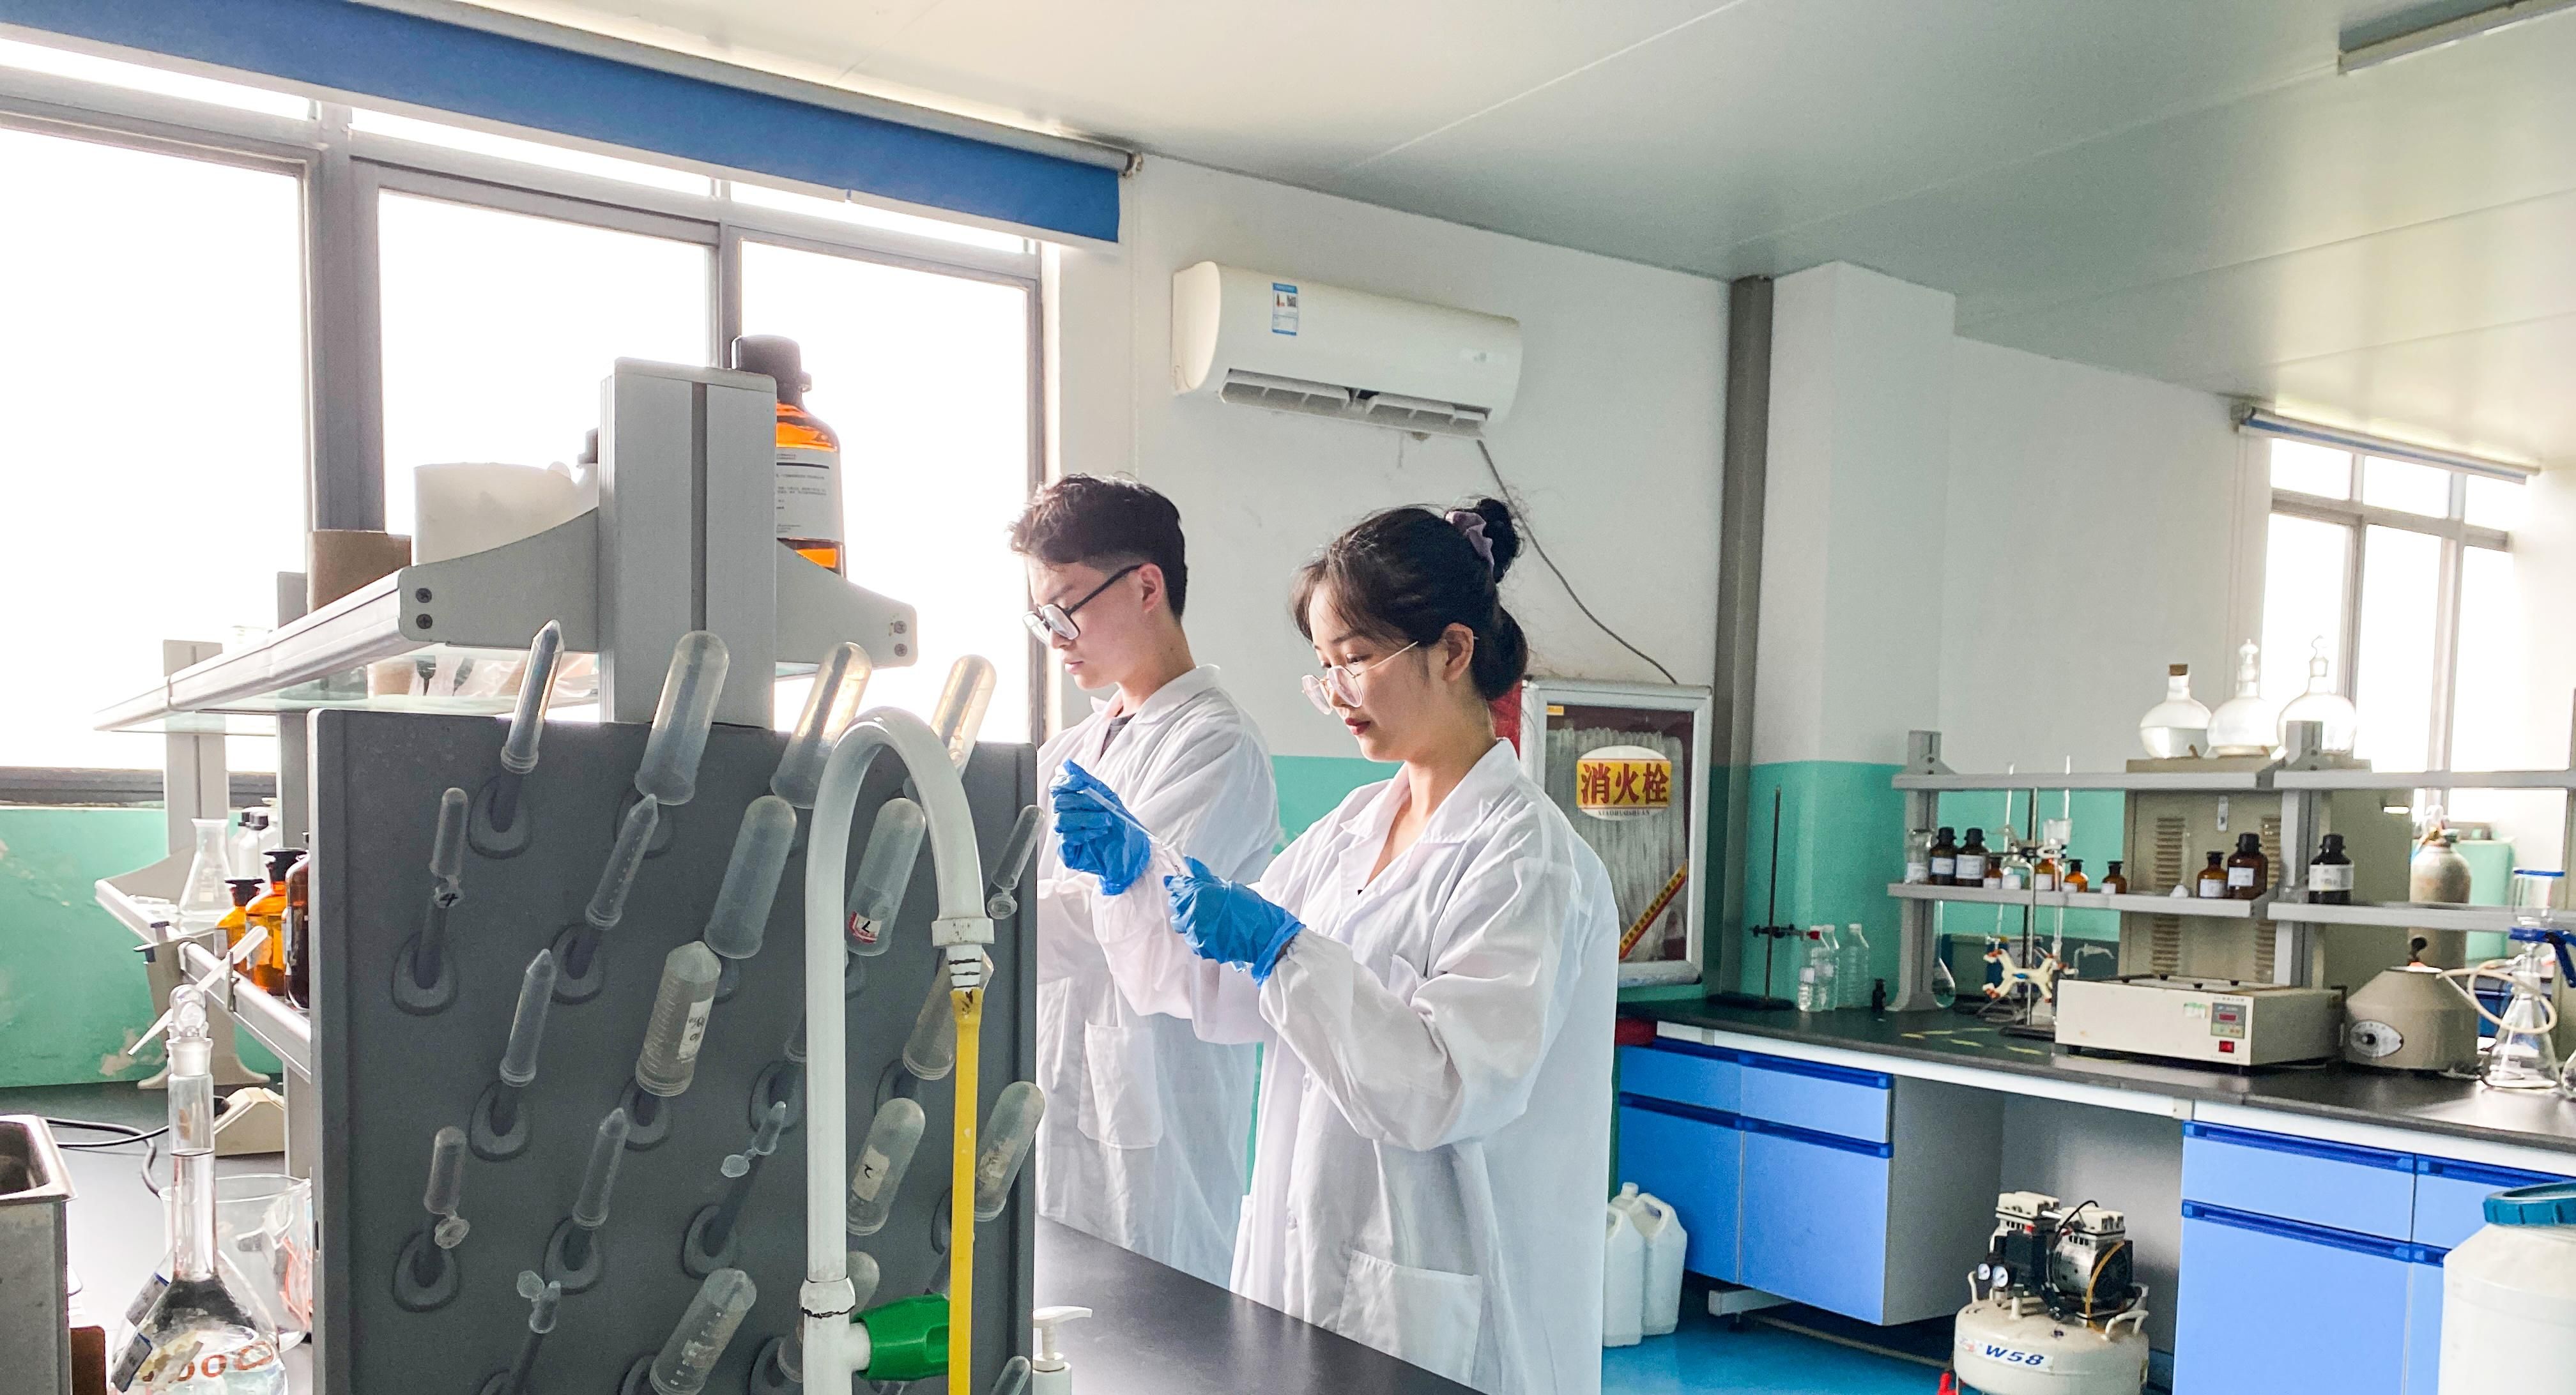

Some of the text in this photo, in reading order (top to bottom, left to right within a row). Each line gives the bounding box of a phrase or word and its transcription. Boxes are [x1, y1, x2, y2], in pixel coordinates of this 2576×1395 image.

[1581, 762, 1669, 805] 消火栓
[1985, 1345, 2044, 1366] W58
